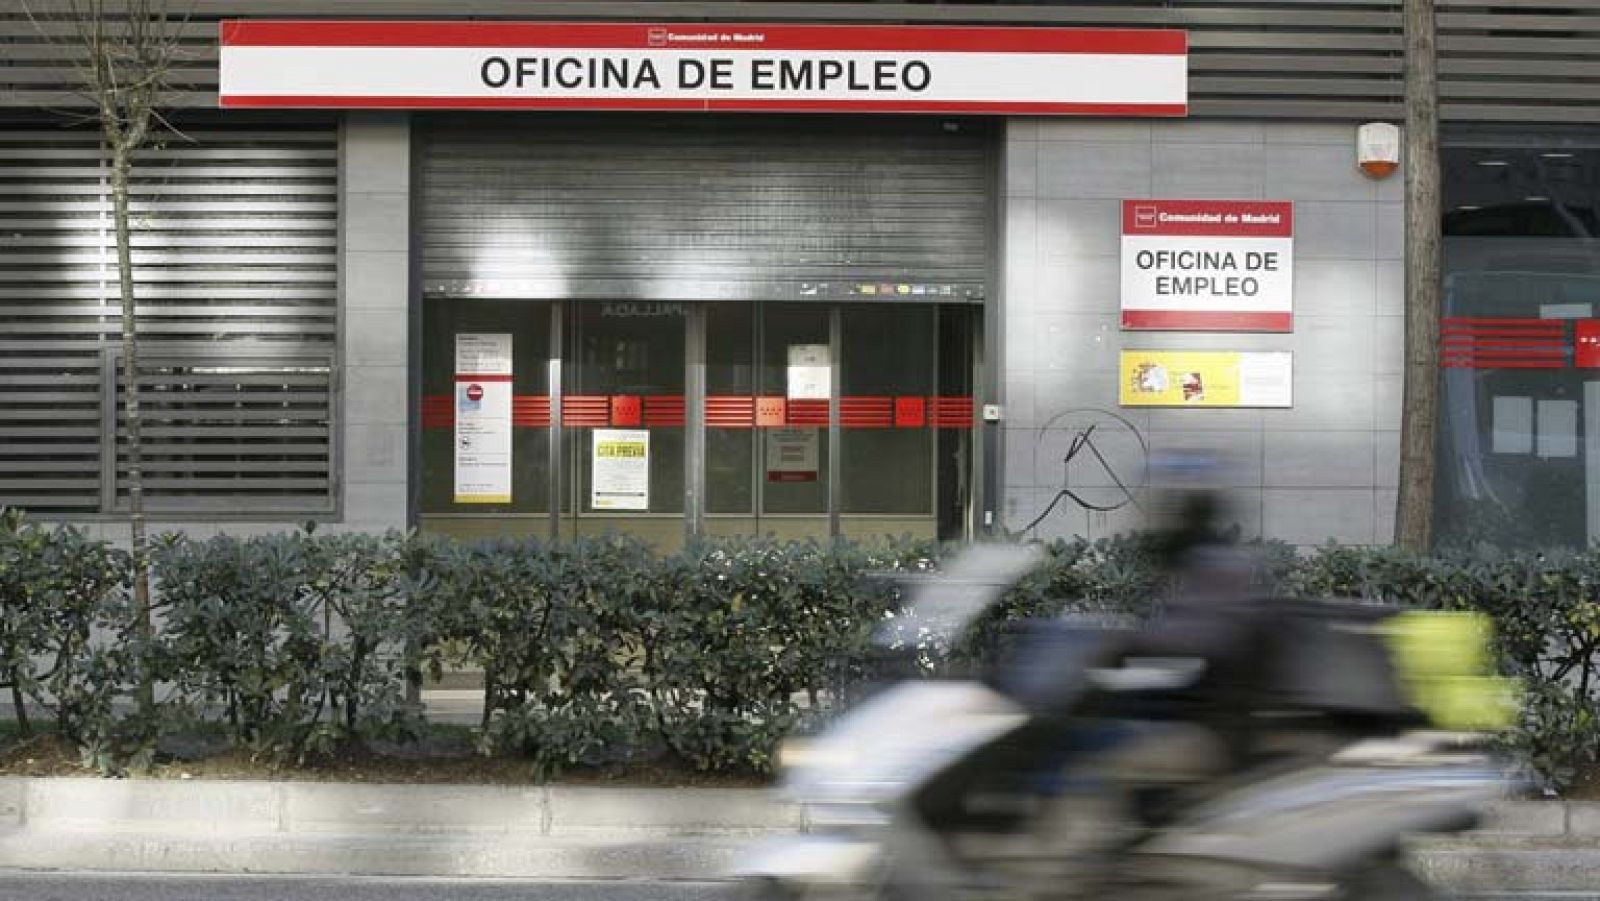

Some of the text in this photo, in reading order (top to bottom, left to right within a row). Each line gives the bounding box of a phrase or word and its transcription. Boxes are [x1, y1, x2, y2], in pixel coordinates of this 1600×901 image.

[668, 33, 765, 42] Comunidad de Madrid
[480, 56, 932, 92] OFICINA DE EMPLEO
[1159, 213, 1280, 224] Comunidad de Madrid
[1136, 250, 1278, 271] OFICINA DE
[1155, 276, 1259, 297] EMPLEO
